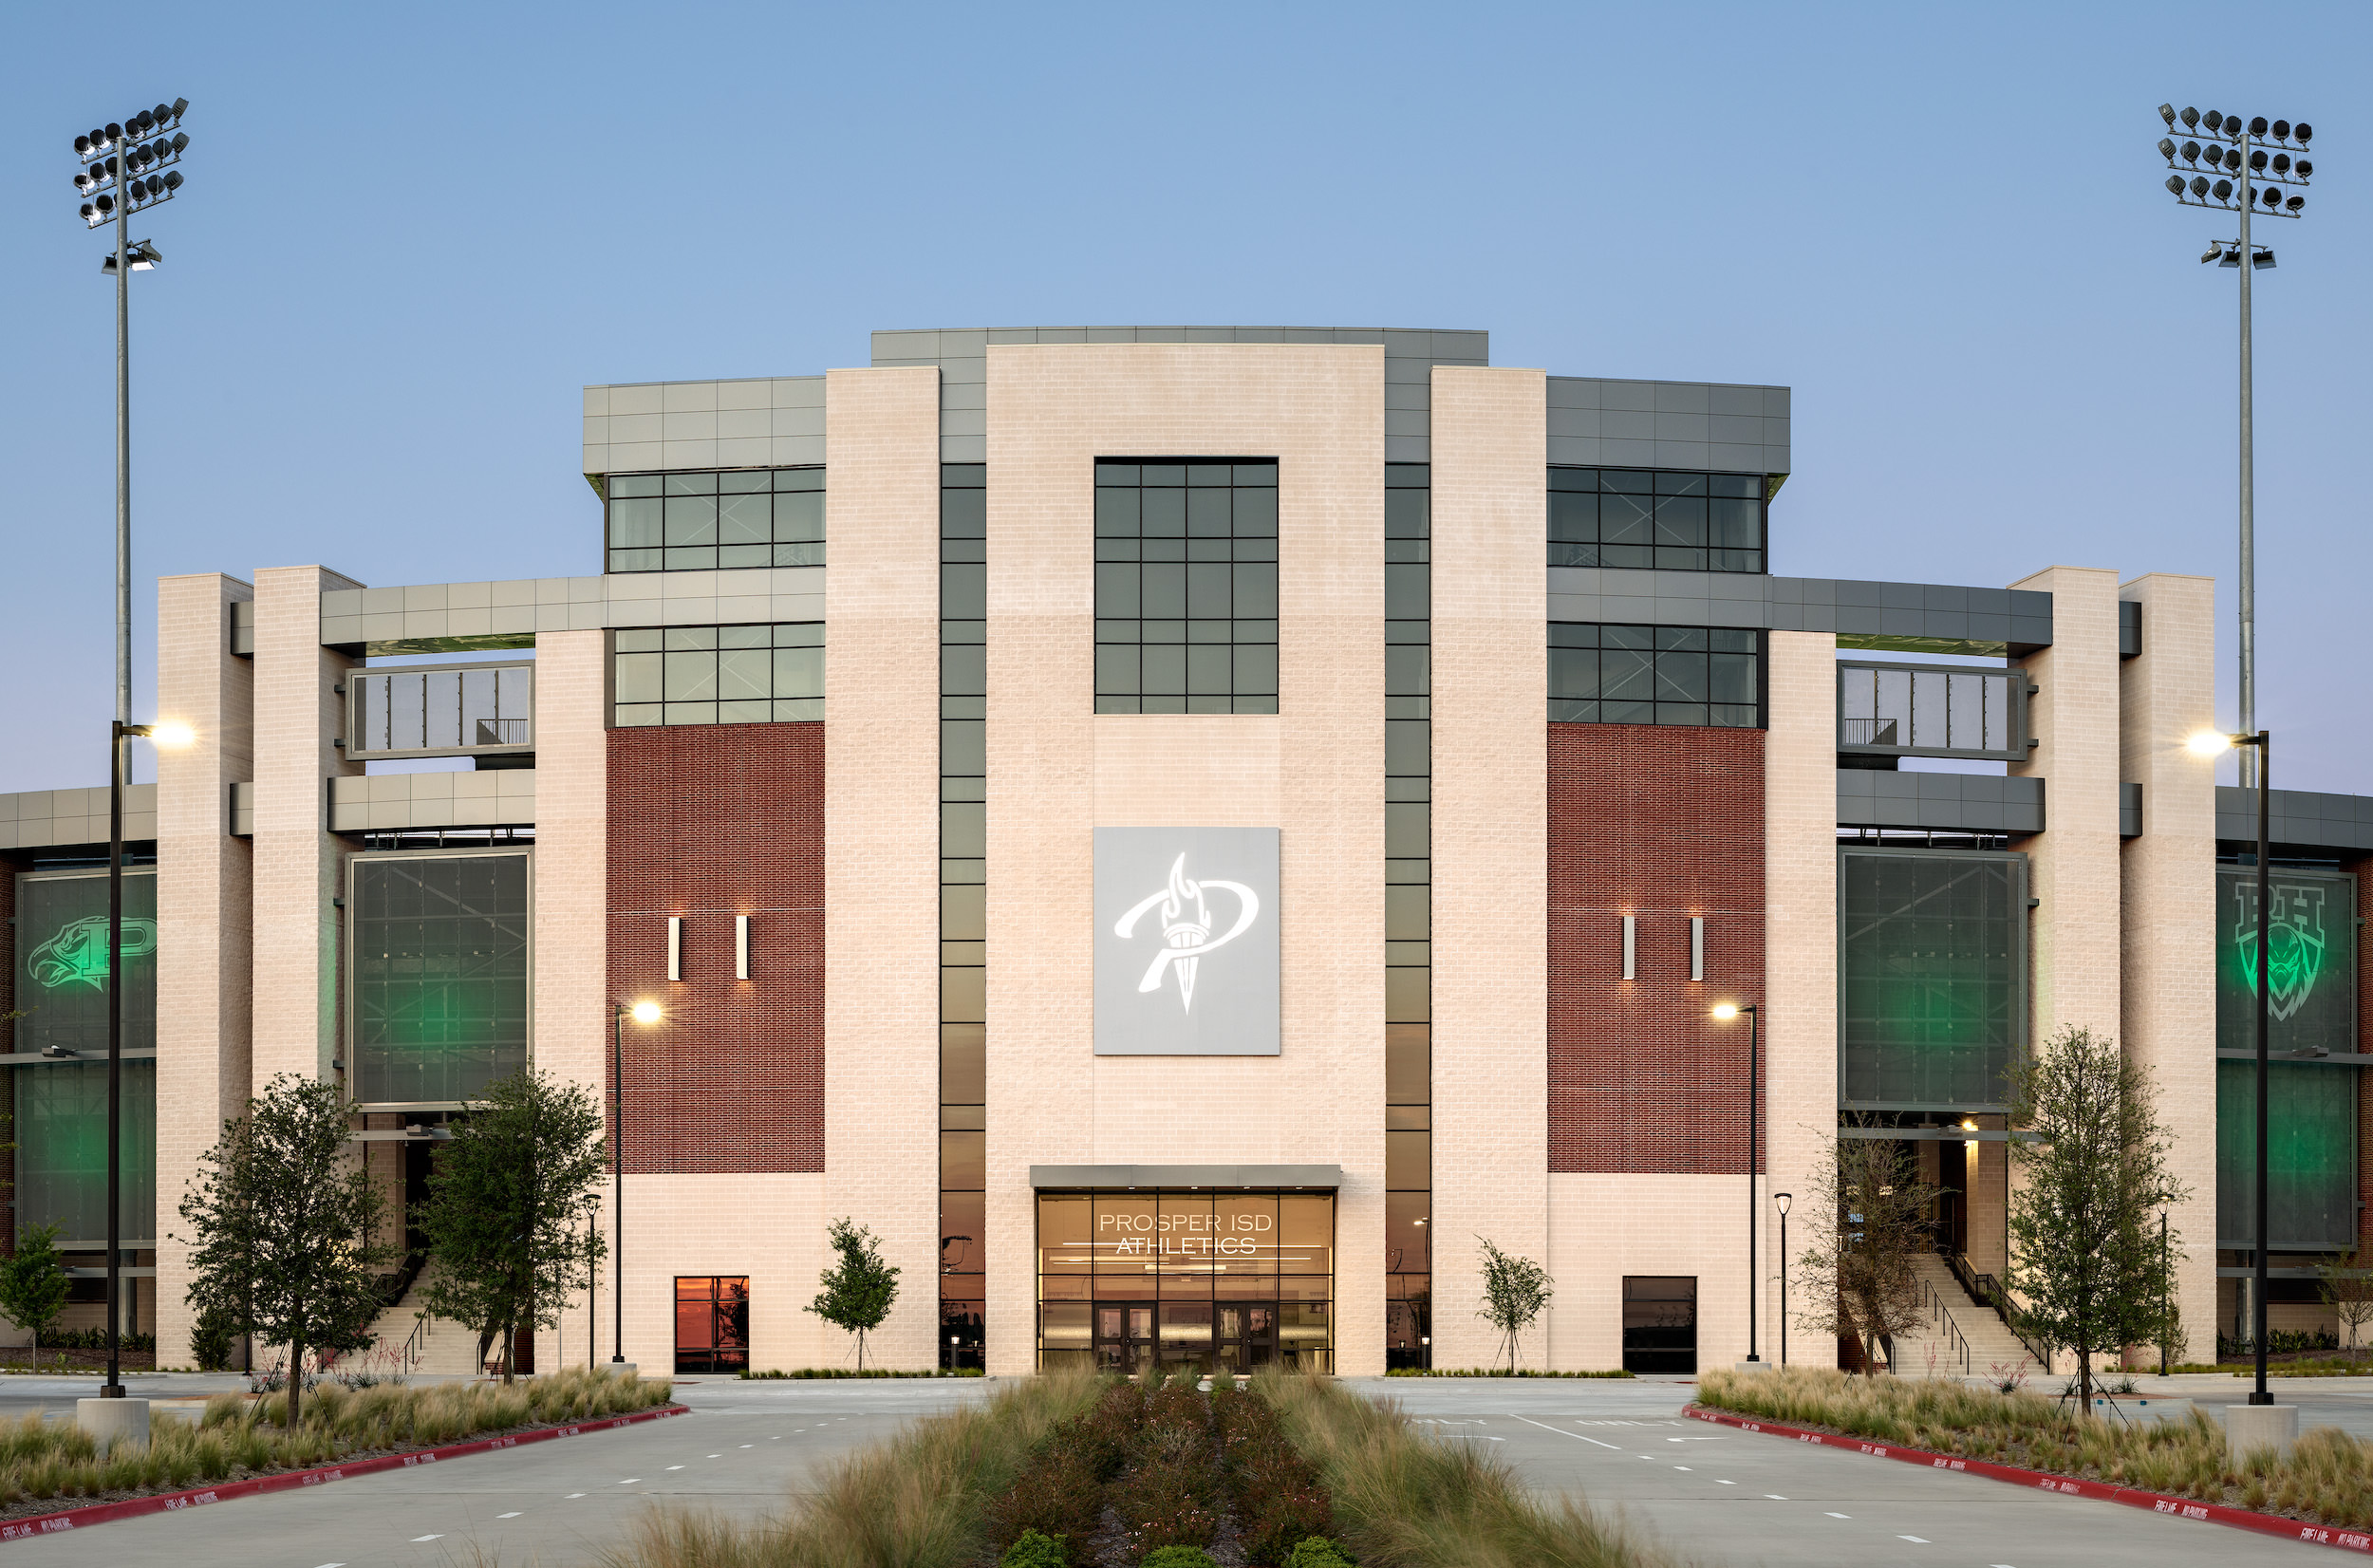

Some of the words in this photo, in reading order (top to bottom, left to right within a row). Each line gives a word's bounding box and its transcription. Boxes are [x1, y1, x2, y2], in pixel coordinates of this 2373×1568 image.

[1099, 1214, 1222, 1232] PROSPER
[1231, 1214, 1273, 1232] ISD
[1115, 1237, 1257, 1255] ATHLETICS
